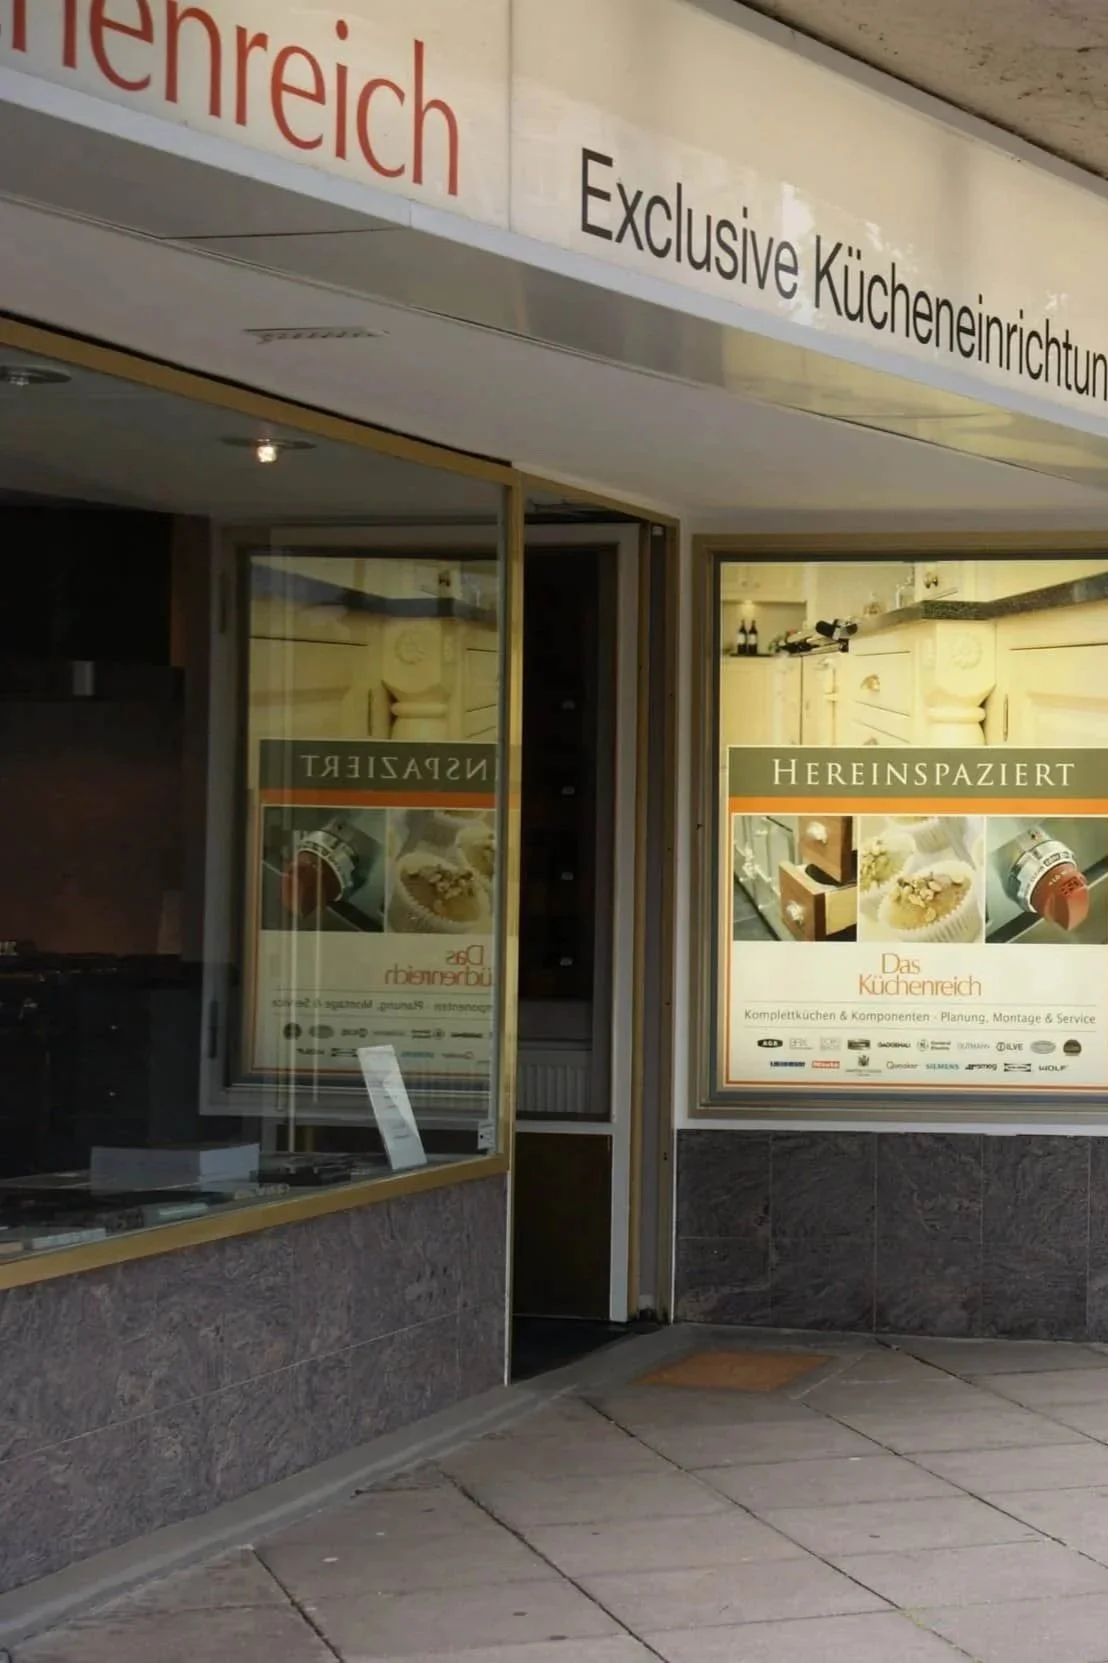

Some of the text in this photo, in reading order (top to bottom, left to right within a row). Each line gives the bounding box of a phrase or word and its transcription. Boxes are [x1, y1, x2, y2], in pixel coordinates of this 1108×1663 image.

[582, 147, 799, 299] Exclusive
[772, 758, 1075, 787] HEREINSPAZIERT
[881, 953, 921, 975] Das
[859, 974, 982, 997] Küchenreich
[840, 1010, 848, 1021] &
[851, 1010, 930, 1023] Komponenten
[993, 1012, 1041, 1026] Montage
[1045, 1013, 1053, 1024] &
[1057, 1013, 1096, 1025] Service
[925, 1063, 960, 1071] SIEMENS
